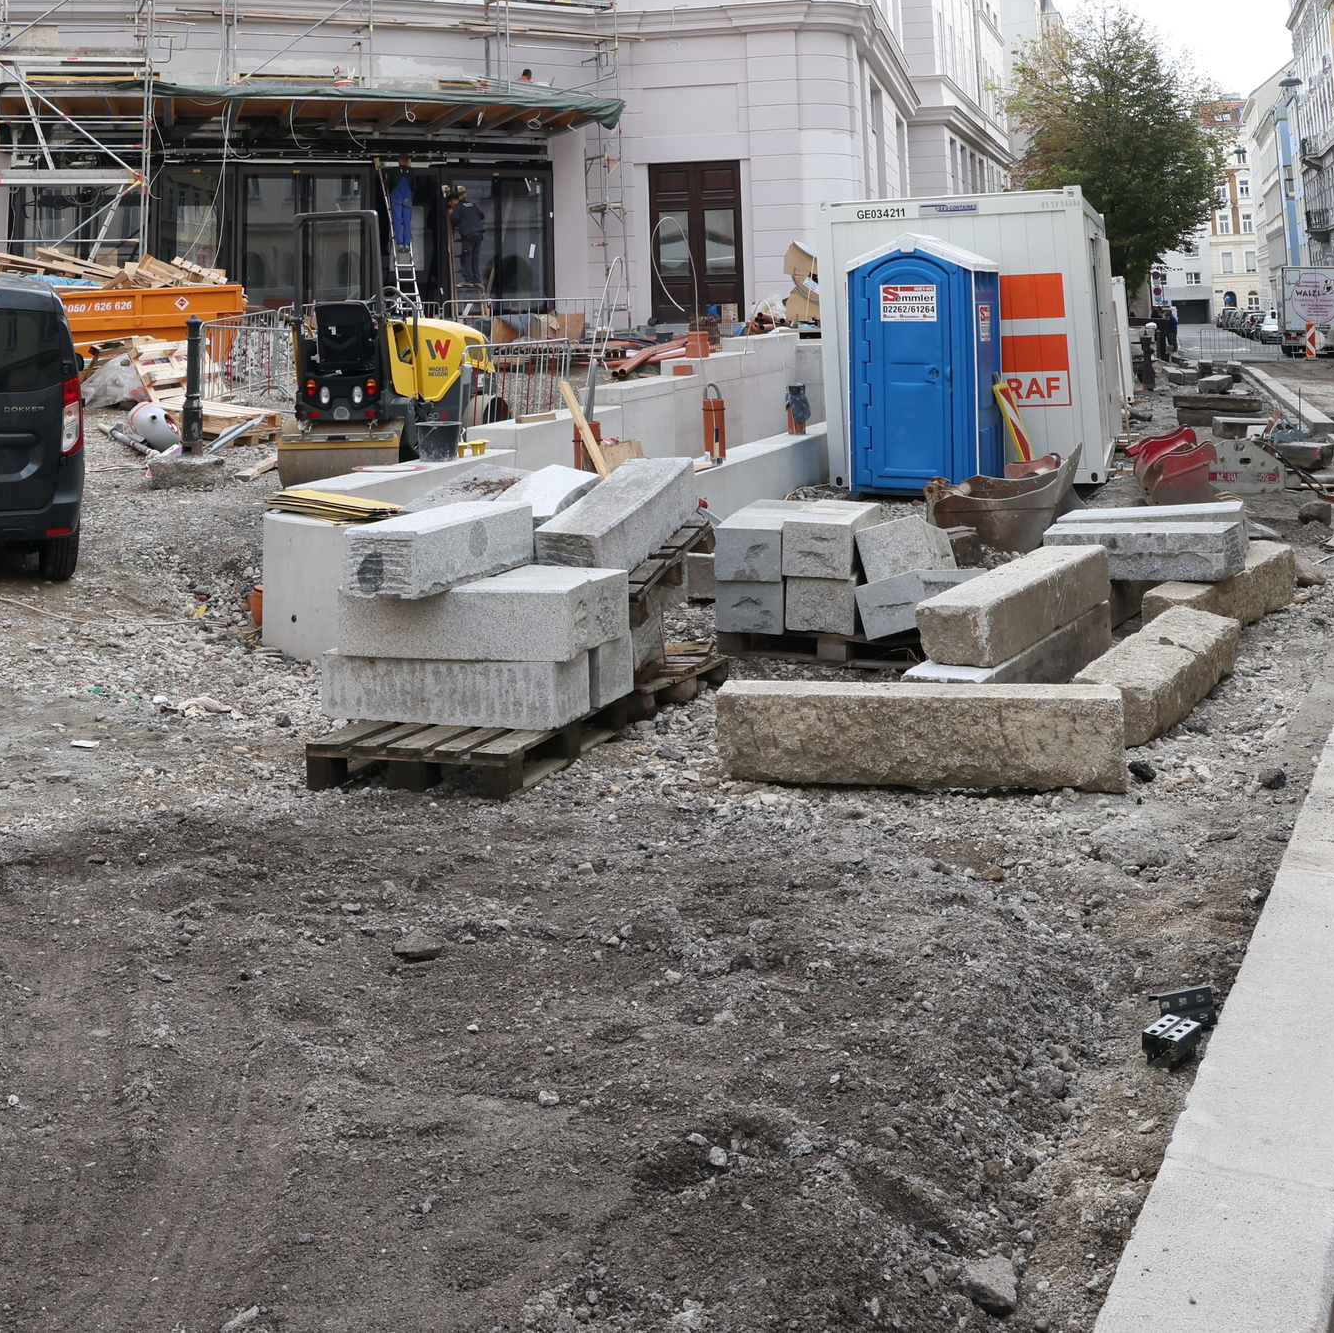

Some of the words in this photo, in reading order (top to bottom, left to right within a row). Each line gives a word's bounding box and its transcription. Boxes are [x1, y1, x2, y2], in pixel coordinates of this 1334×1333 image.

[856, 207, 906, 219] GE034211
[882, 286, 934, 302] Semmler
[68, 304, 85, 313] 050
[94, 302, 111, 311] 626
[114, 301, 132, 310] 626
